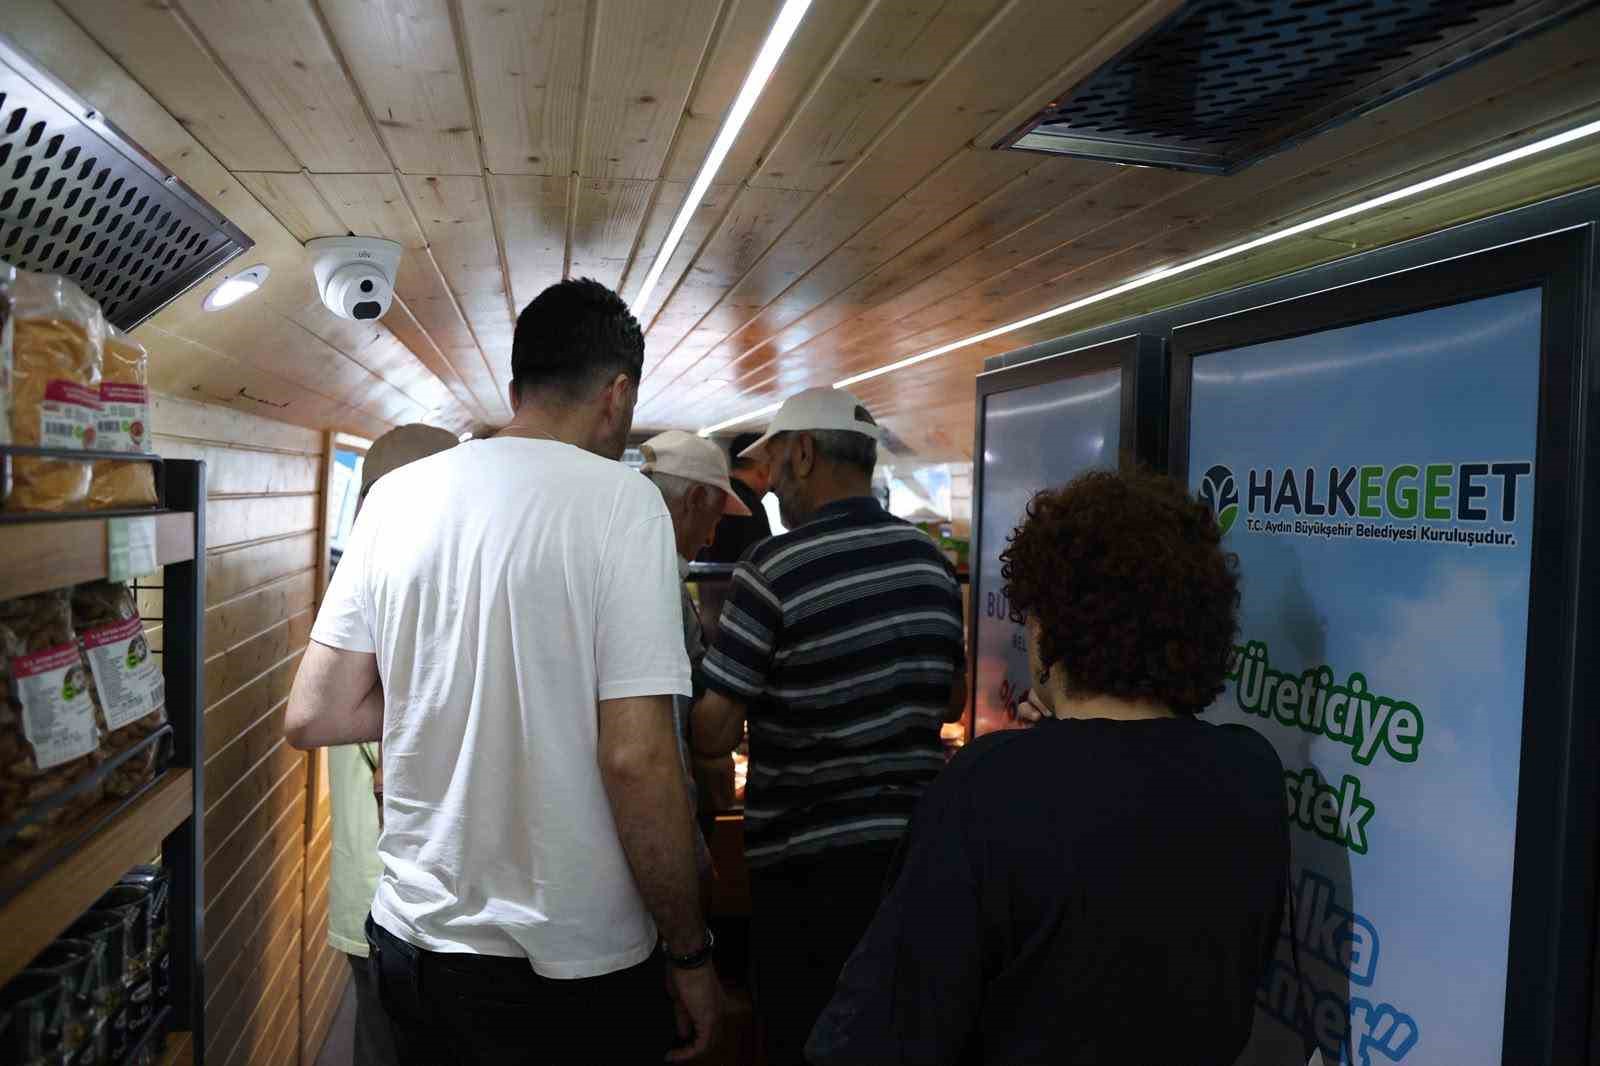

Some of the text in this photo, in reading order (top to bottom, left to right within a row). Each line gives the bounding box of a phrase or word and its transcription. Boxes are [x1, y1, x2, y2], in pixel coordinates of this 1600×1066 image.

[1247, 461, 1531, 522] HALKEGEET
[1246, 519, 1516, 547] T.C. Aydın Büyükşehir Belediyesi Kuruluşudur.
[1283, 770, 1375, 853] stek
[1296, 870, 1378, 986] lka
